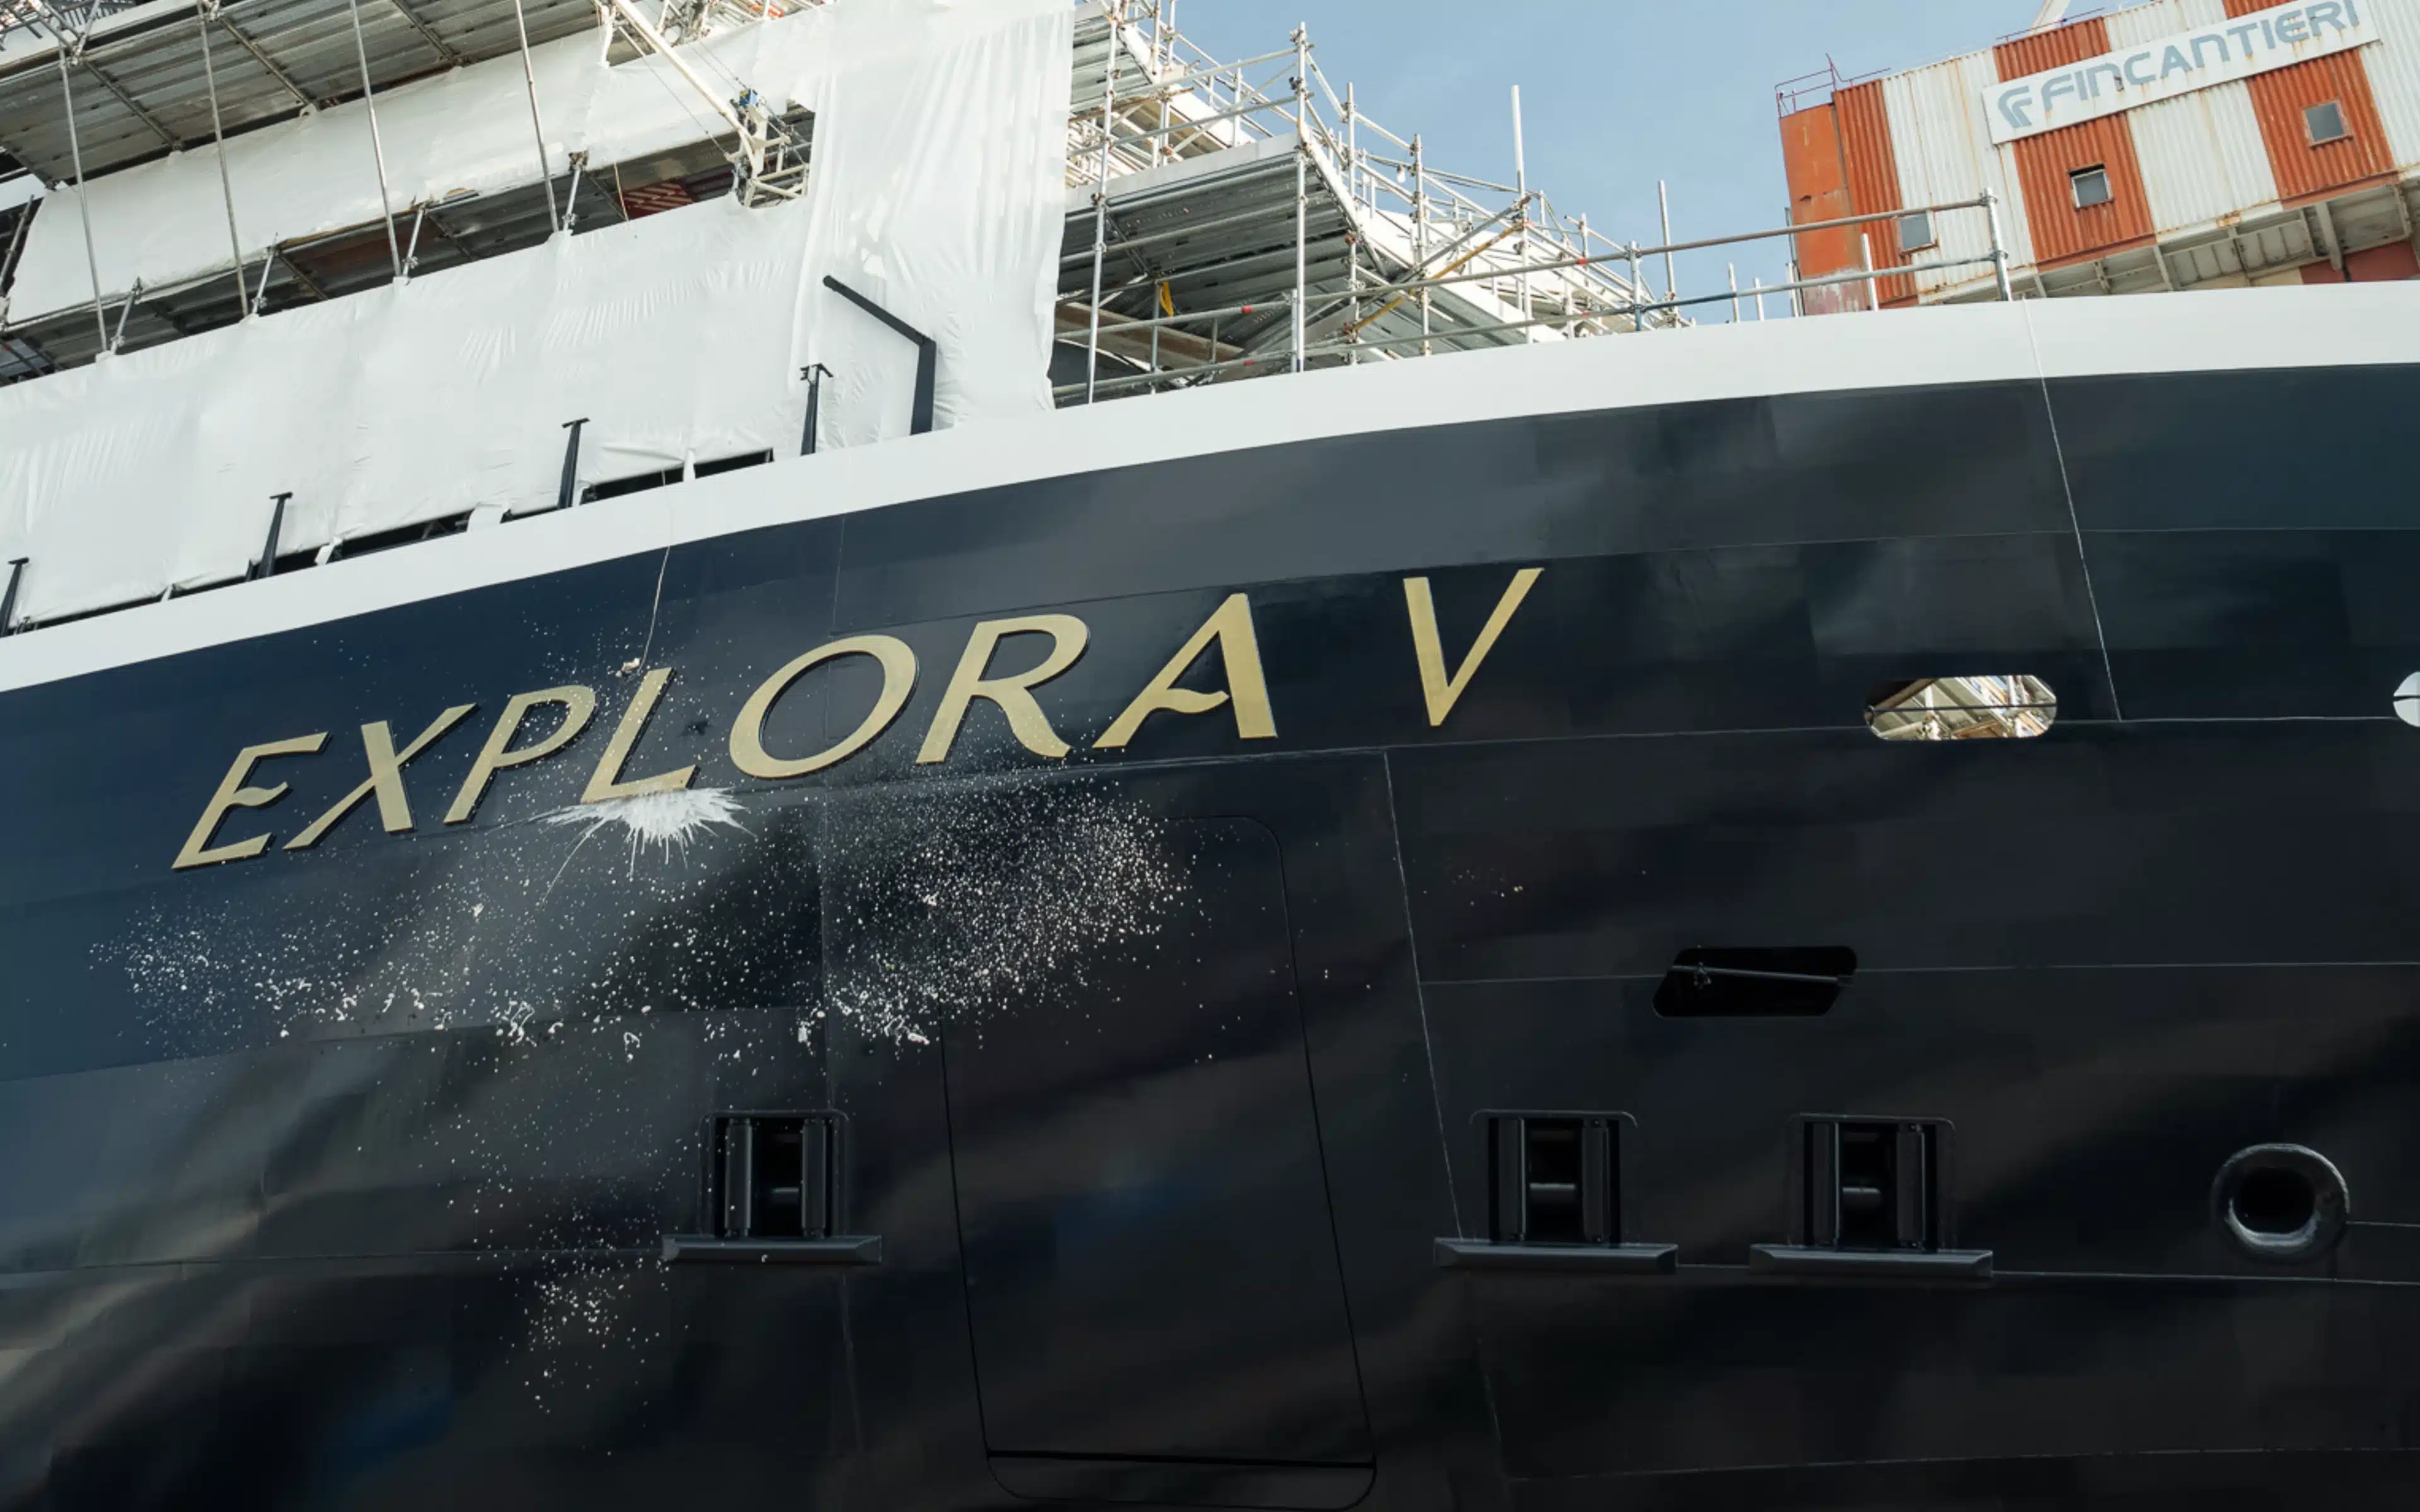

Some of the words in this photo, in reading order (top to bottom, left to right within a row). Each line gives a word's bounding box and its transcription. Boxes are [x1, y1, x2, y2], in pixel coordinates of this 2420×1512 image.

[2041, 0, 2360, 111] FINCANTIERI
[170, 592, 1279, 871] EXPLORA
[1402, 567, 1545, 728] V
